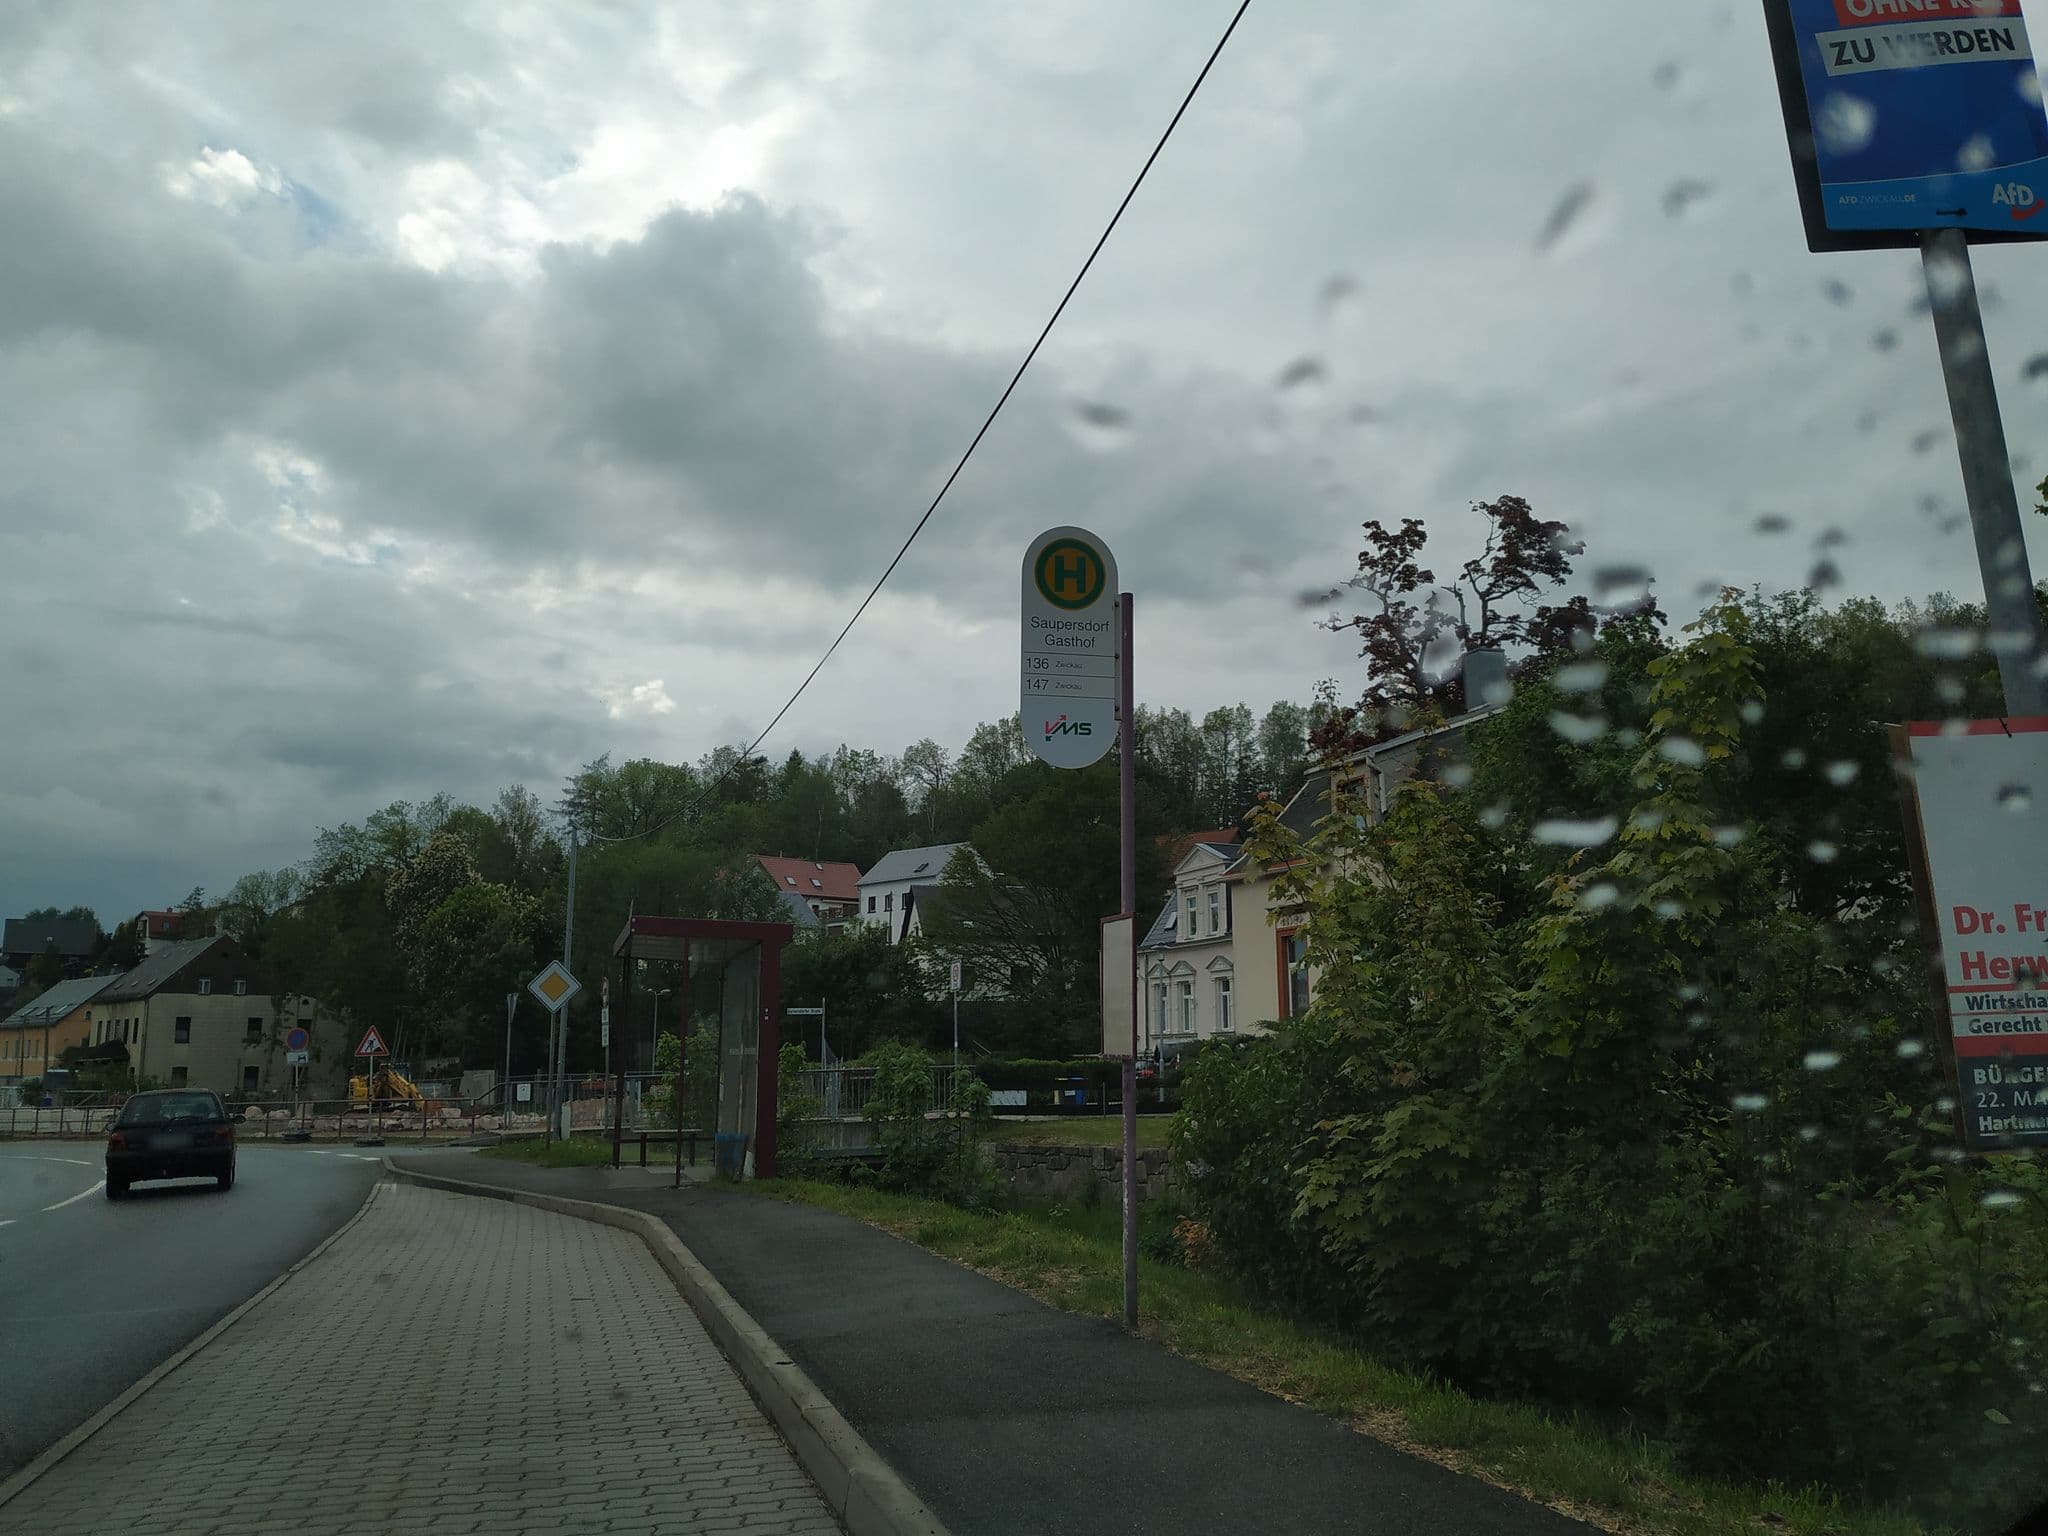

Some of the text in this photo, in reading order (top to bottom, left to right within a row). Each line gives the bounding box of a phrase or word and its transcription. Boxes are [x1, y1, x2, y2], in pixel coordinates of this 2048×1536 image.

[1829, 28, 2016, 67] ZU ERDEN
[1992, 182, 2034, 206] AfD
[1054, 555, 1086, 593] H
[1030, 616, 1110, 633] Saupersdorf
[1044, 634, 1096, 648] Gasthof
[1026, 657, 1050, 670] 136
[1026, 678, 1049, 691] 147
[1045, 715, 1092, 737] VMS
[1952, 905, 2006, 935] Dr.
[1965, 991, 2048, 1012] Wirtscha
[1968, 1015, 2042, 1034] Gerecht
[1973, 1064, 2048, 1086] BÜGE
[1977, 1091, 2006, 1109] 22.
[1979, 1114, 2048, 1132] Hartma
